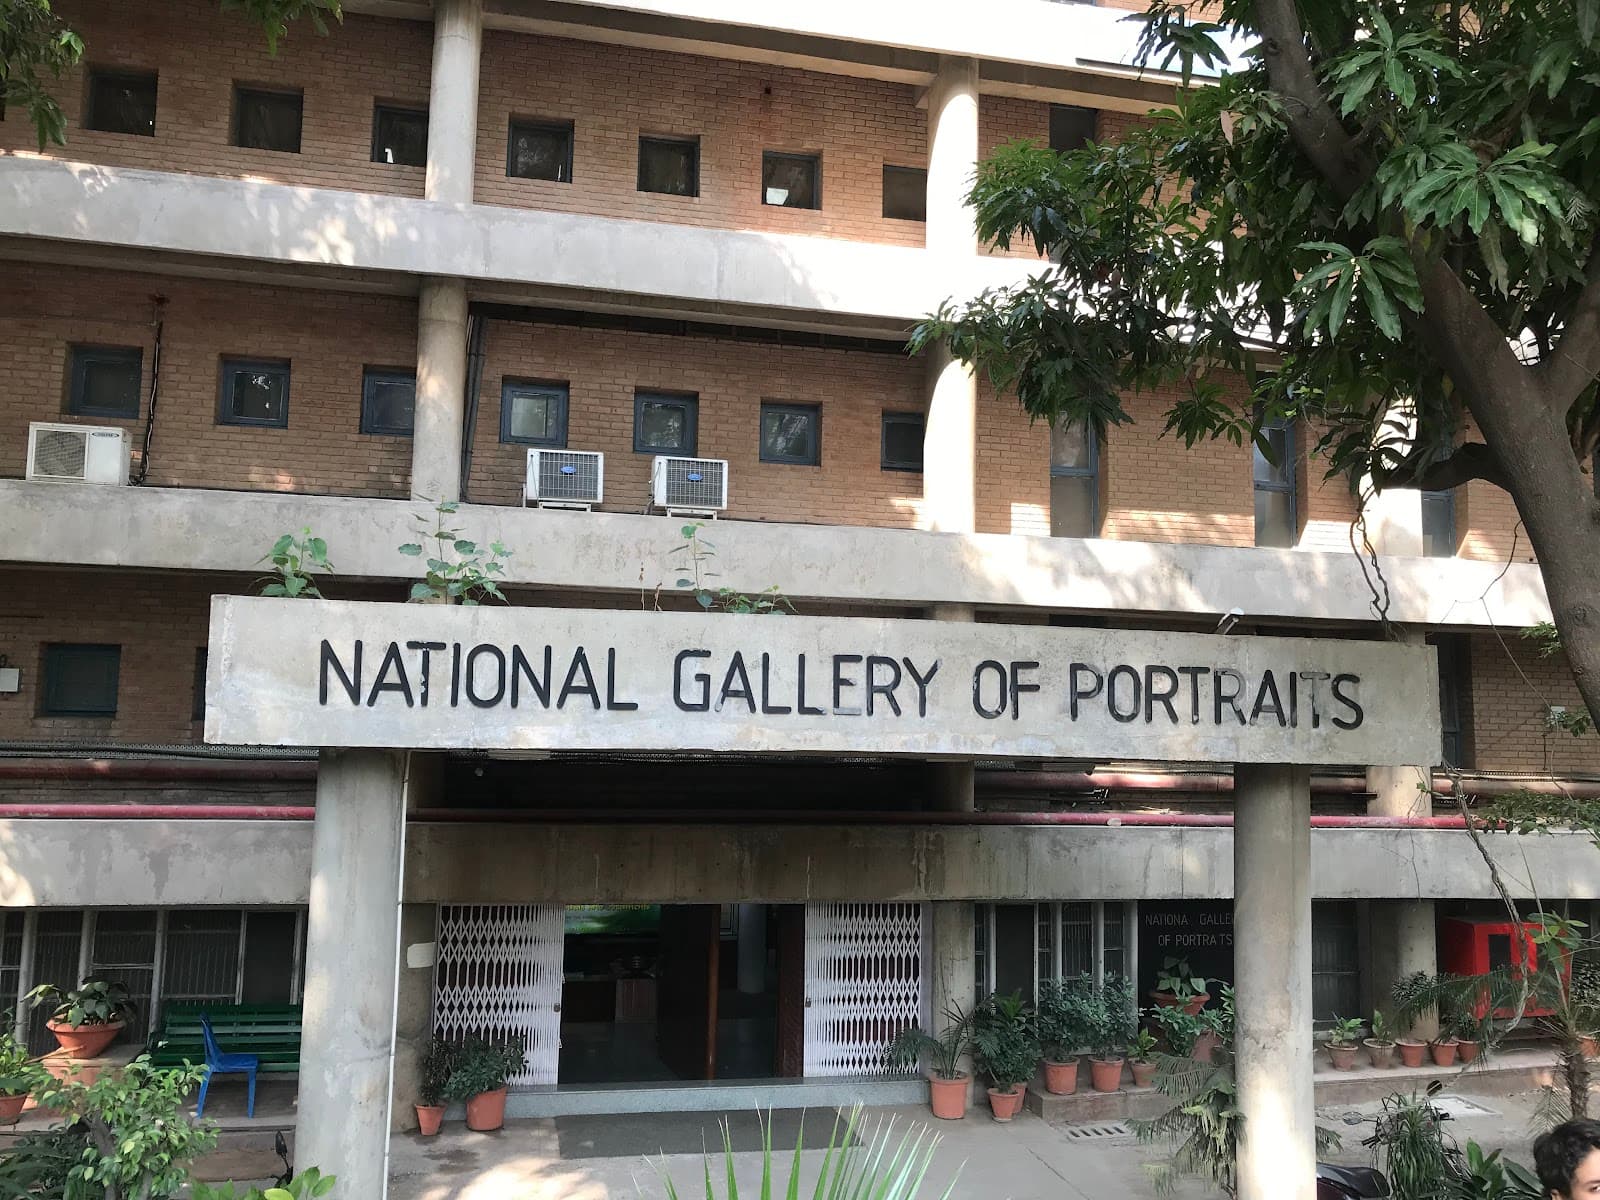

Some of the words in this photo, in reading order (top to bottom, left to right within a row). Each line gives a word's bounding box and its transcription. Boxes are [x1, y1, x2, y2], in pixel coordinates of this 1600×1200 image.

[319, 639, 639, 711] NATIONAL
[673, 649, 942, 718] GALLERY
[972, 659, 1040, 721] OF
[1070, 662, 1364, 730] PORTRAITS
[1145, 913, 1190, 926] NATIONA
[1199, 913, 1232, 925] GALLE
[1158, 934, 1170, 946] OF
[1175, 933, 1232, 946] PORTRATS
